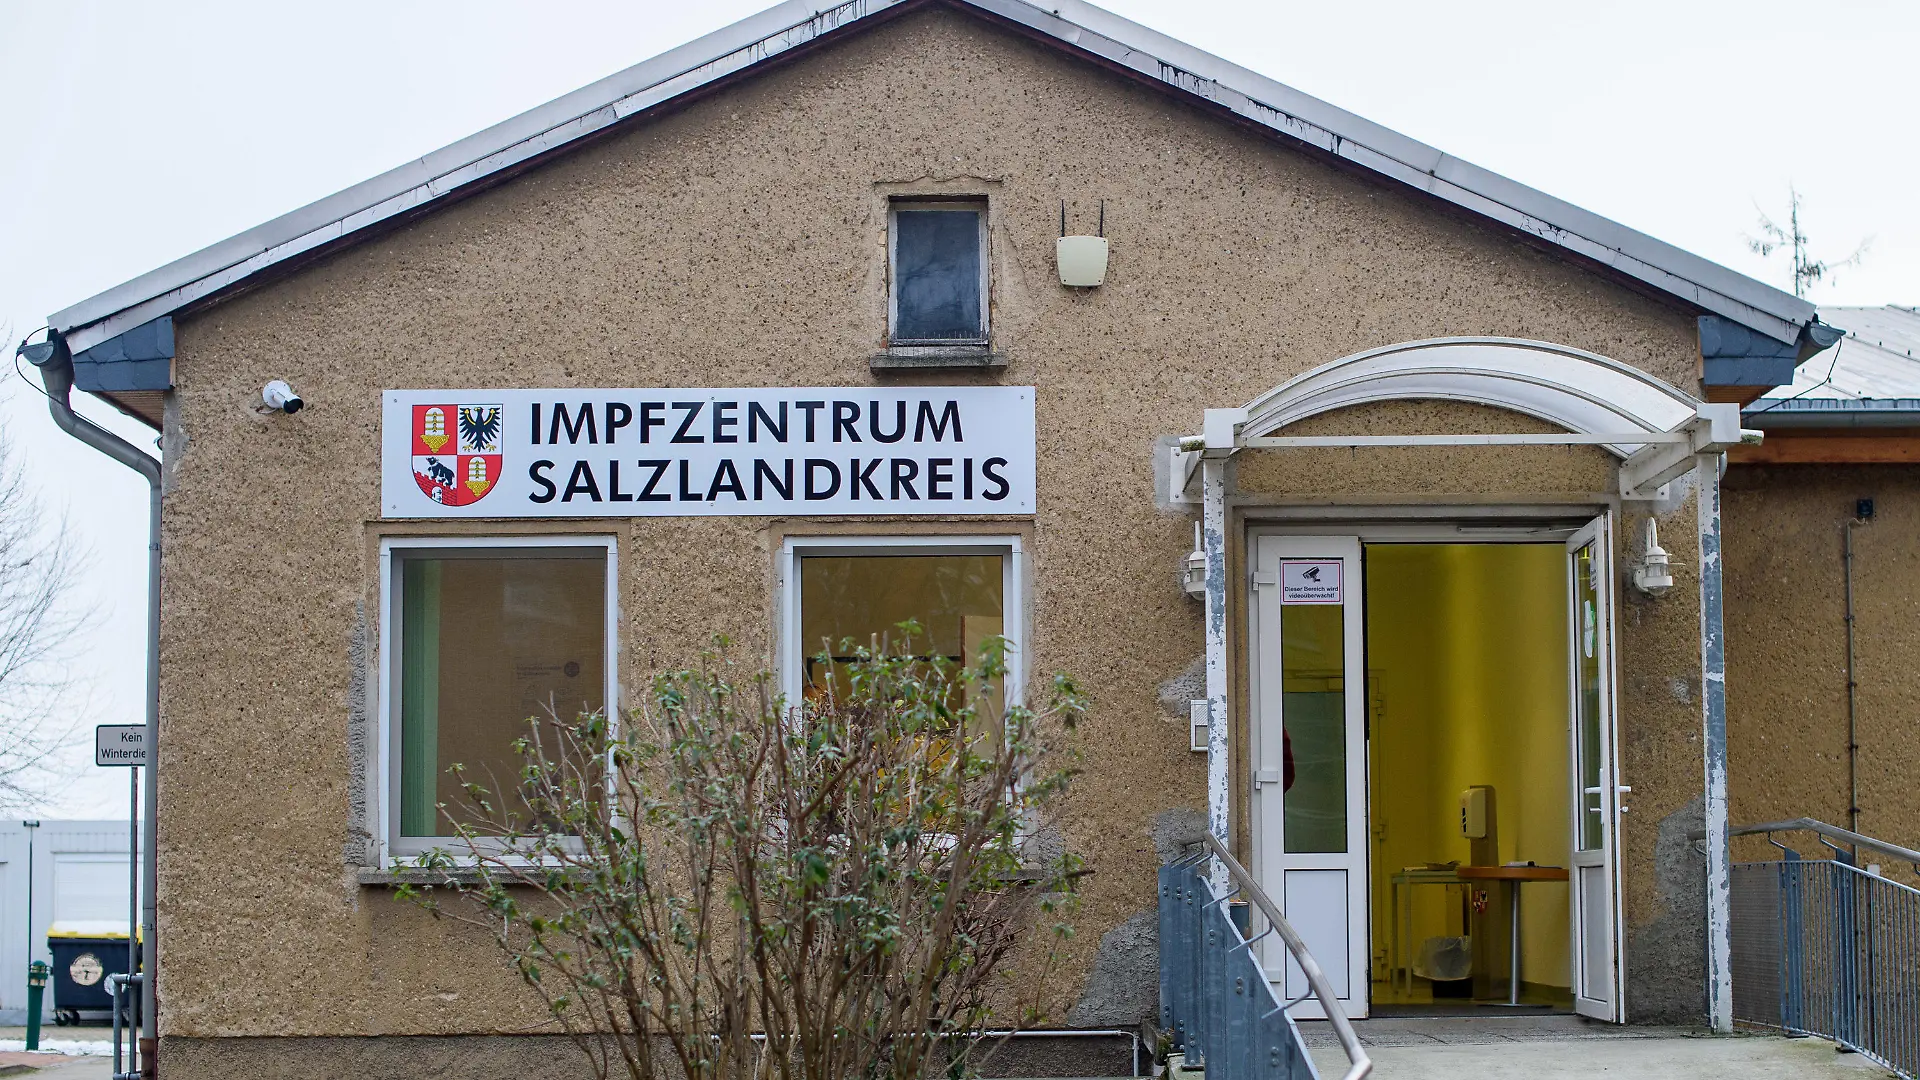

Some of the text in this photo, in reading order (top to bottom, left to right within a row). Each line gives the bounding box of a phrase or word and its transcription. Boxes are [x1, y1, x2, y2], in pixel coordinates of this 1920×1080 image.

[530, 400, 964, 445] IMPFZENTRUM
[528, 456, 1010, 503] SALZLANDKREIS
[121, 732, 142, 742] Kein
